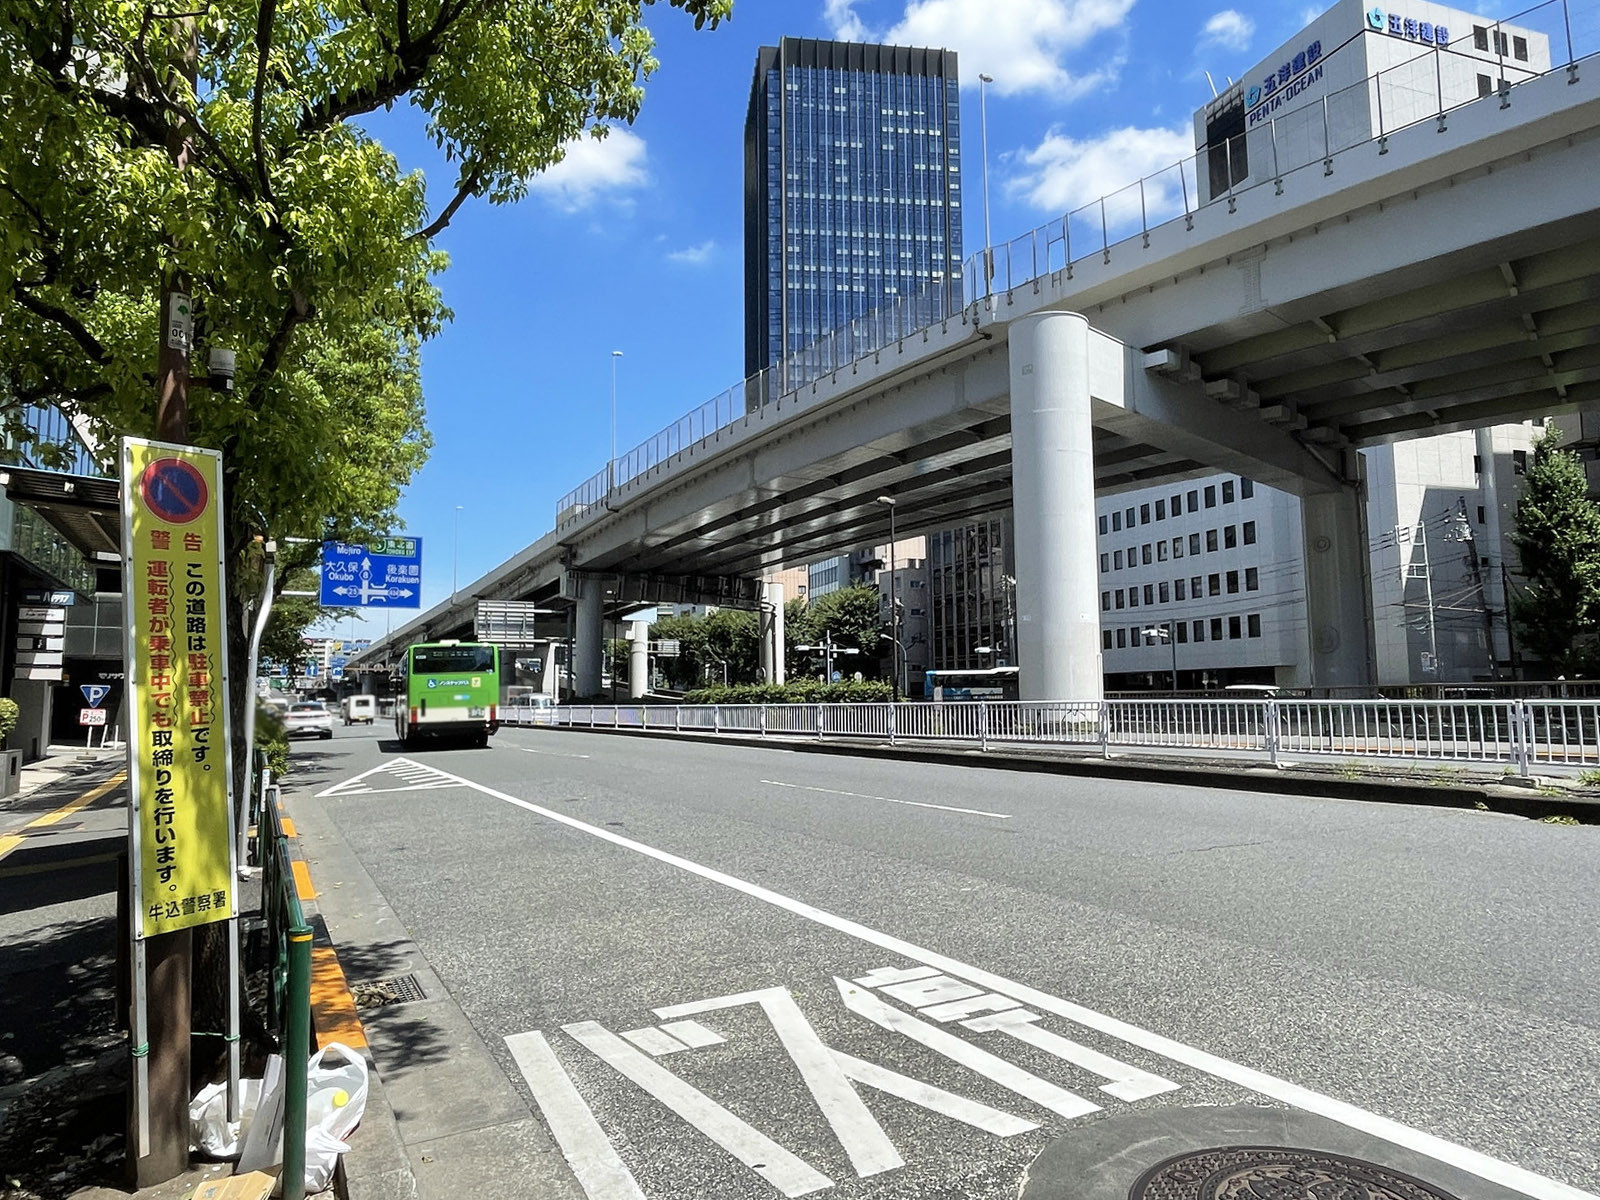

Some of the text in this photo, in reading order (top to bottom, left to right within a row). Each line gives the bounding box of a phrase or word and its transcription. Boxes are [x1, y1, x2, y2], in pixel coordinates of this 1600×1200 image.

[1388, 13, 1449, 47] 五洋建設
[1263, 40, 1323, 96] 五洋建設
[1249, 65, 1323, 127] PENTA-OCEAN
[150, 529, 203, 553] 警告
[325, 561, 359, 573] 大久保
[328, 572, 355, 581] Okubo
[362, 571, 369, 579] 8
[385, 575, 420, 584] Korakuen
[387, 564, 419, 576] 後楽園
[185, 563, 211, 771] この道路は駐車禁止です。
[147, 560, 177, 892] 運転者が乗車中でも取締りを行います。
[148, 890, 227, 922] 牛込警察署
[502, 966, 1183, 1200] バス停
